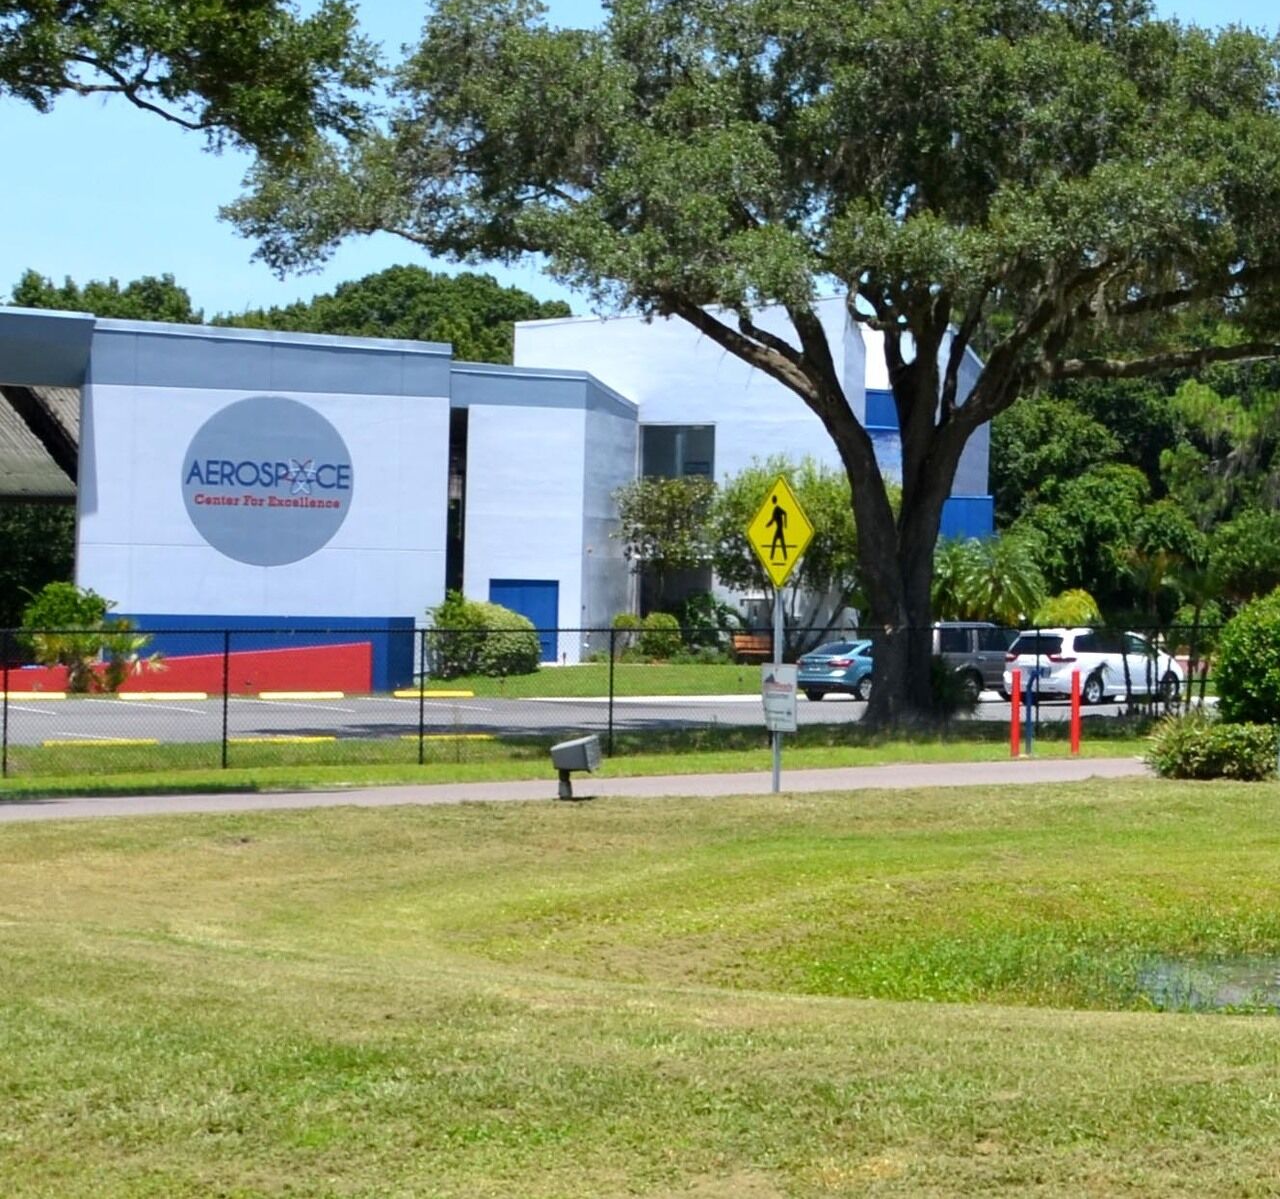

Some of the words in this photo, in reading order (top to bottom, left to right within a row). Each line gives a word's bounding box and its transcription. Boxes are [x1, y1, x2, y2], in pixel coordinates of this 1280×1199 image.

[185, 459, 350, 491] AEROSPACE
[194, 493, 240, 506] Center
[241, 495, 265, 507] For
[267, 496, 341, 508] Excellence
